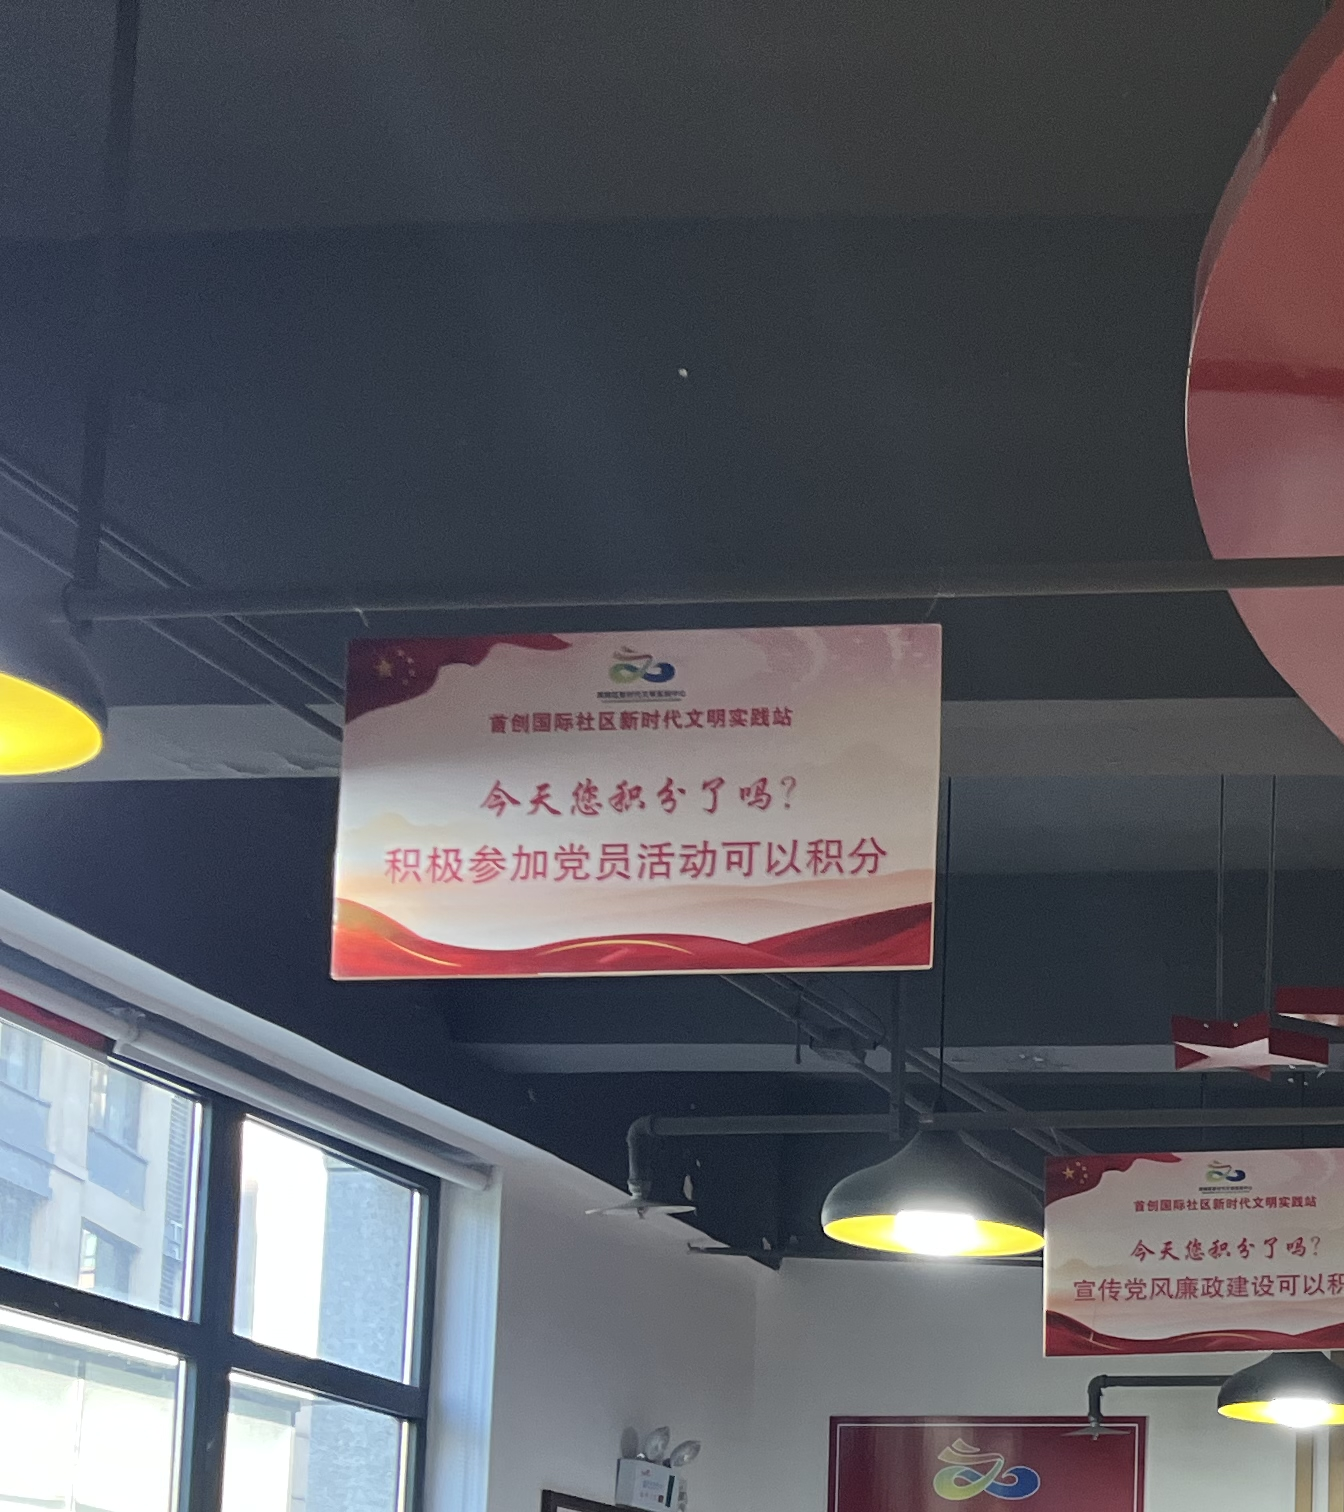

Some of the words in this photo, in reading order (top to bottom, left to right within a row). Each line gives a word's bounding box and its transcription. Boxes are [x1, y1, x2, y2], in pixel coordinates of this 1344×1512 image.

[489, 707, 794, 735] 首创国际社区新时代文明实践站
[479, 776, 798, 818] 今天您积分了吗？
[385, 836, 888, 885] 积极参加党员活动可以积分
